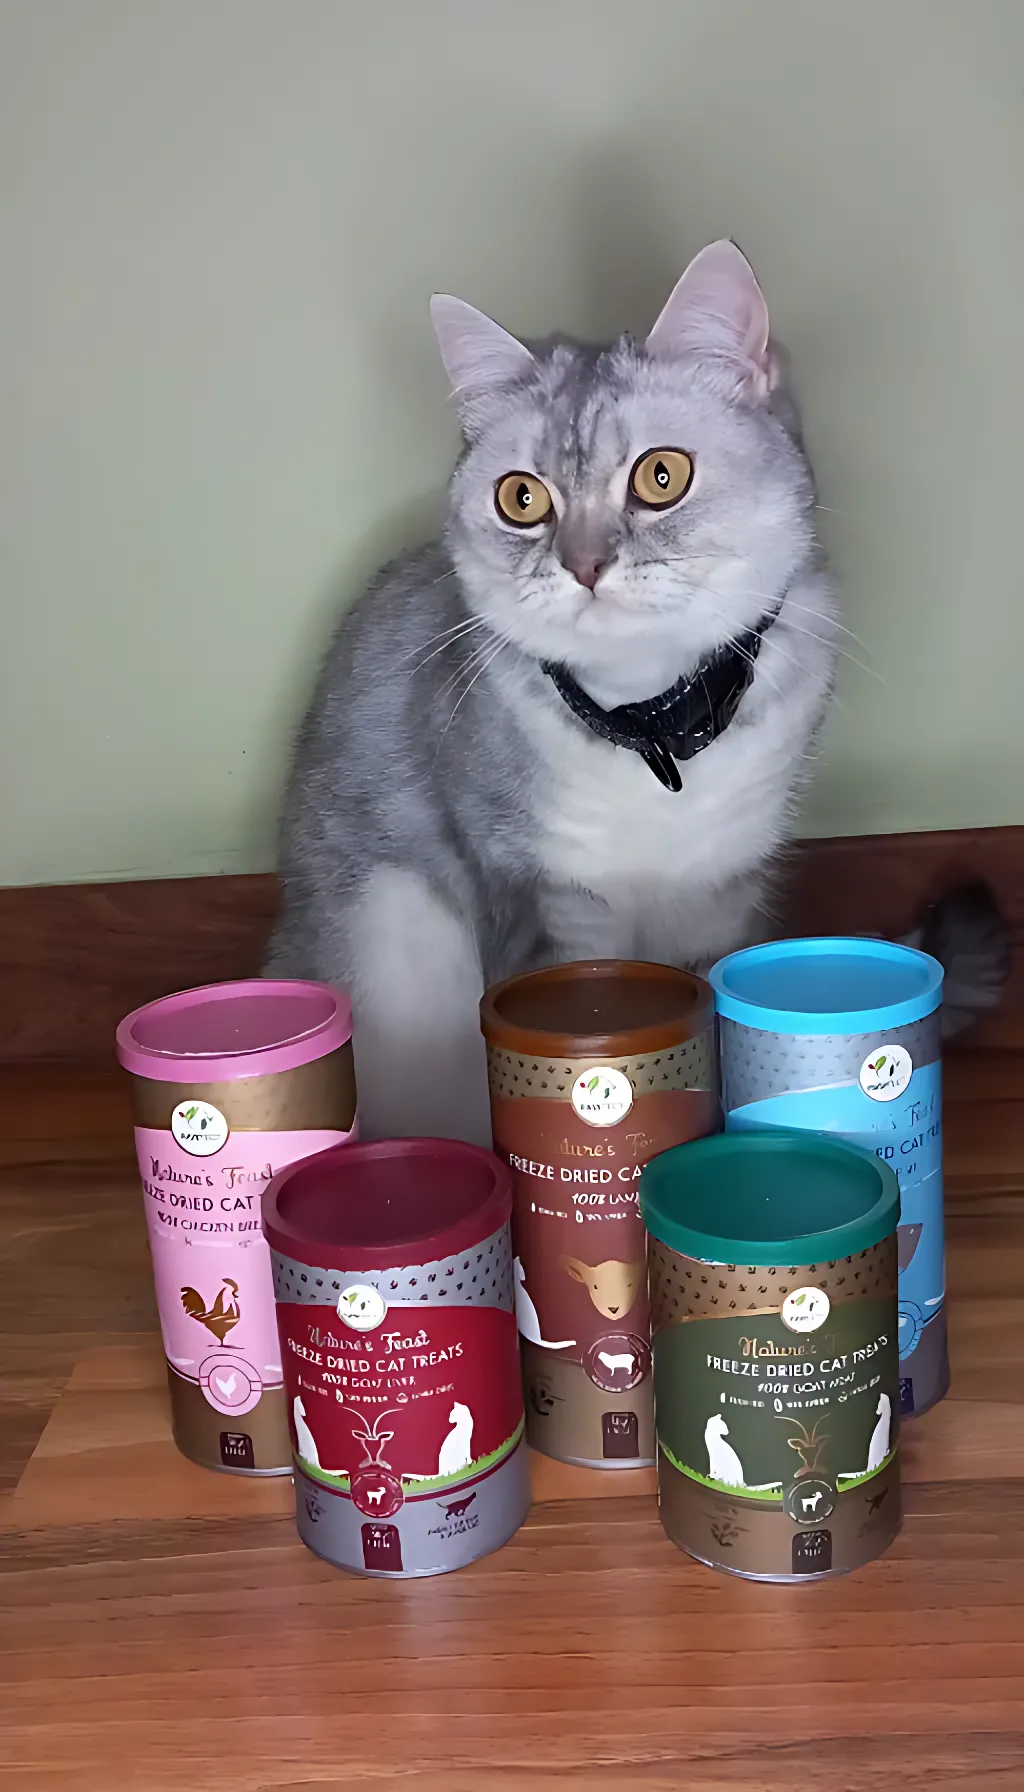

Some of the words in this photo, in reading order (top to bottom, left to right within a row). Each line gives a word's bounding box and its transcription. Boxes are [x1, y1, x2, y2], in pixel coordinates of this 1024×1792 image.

[509, 1153, 554, 1180] FREEZE
[560, 1167, 613, 1183] DRIED
[618, 1164, 648, 1181] CA
[170, 1193, 214, 1211] DRIED
[220, 1196, 254, 1212] CAT
[572, 1192, 605, 1205] 100%
[307, 1324, 374, 1352] Nature's
[380, 1329, 430, 1354] Feast
[327, 1355, 370, 1373] DRIED
[376, 1357, 405, 1373] CAT
[412, 1342, 464, 1369] TREATS
[707, 1354, 759, 1376] FREEZE
[766, 1363, 815, 1377] DRIED
[819, 1355, 848, 1373] CAT
